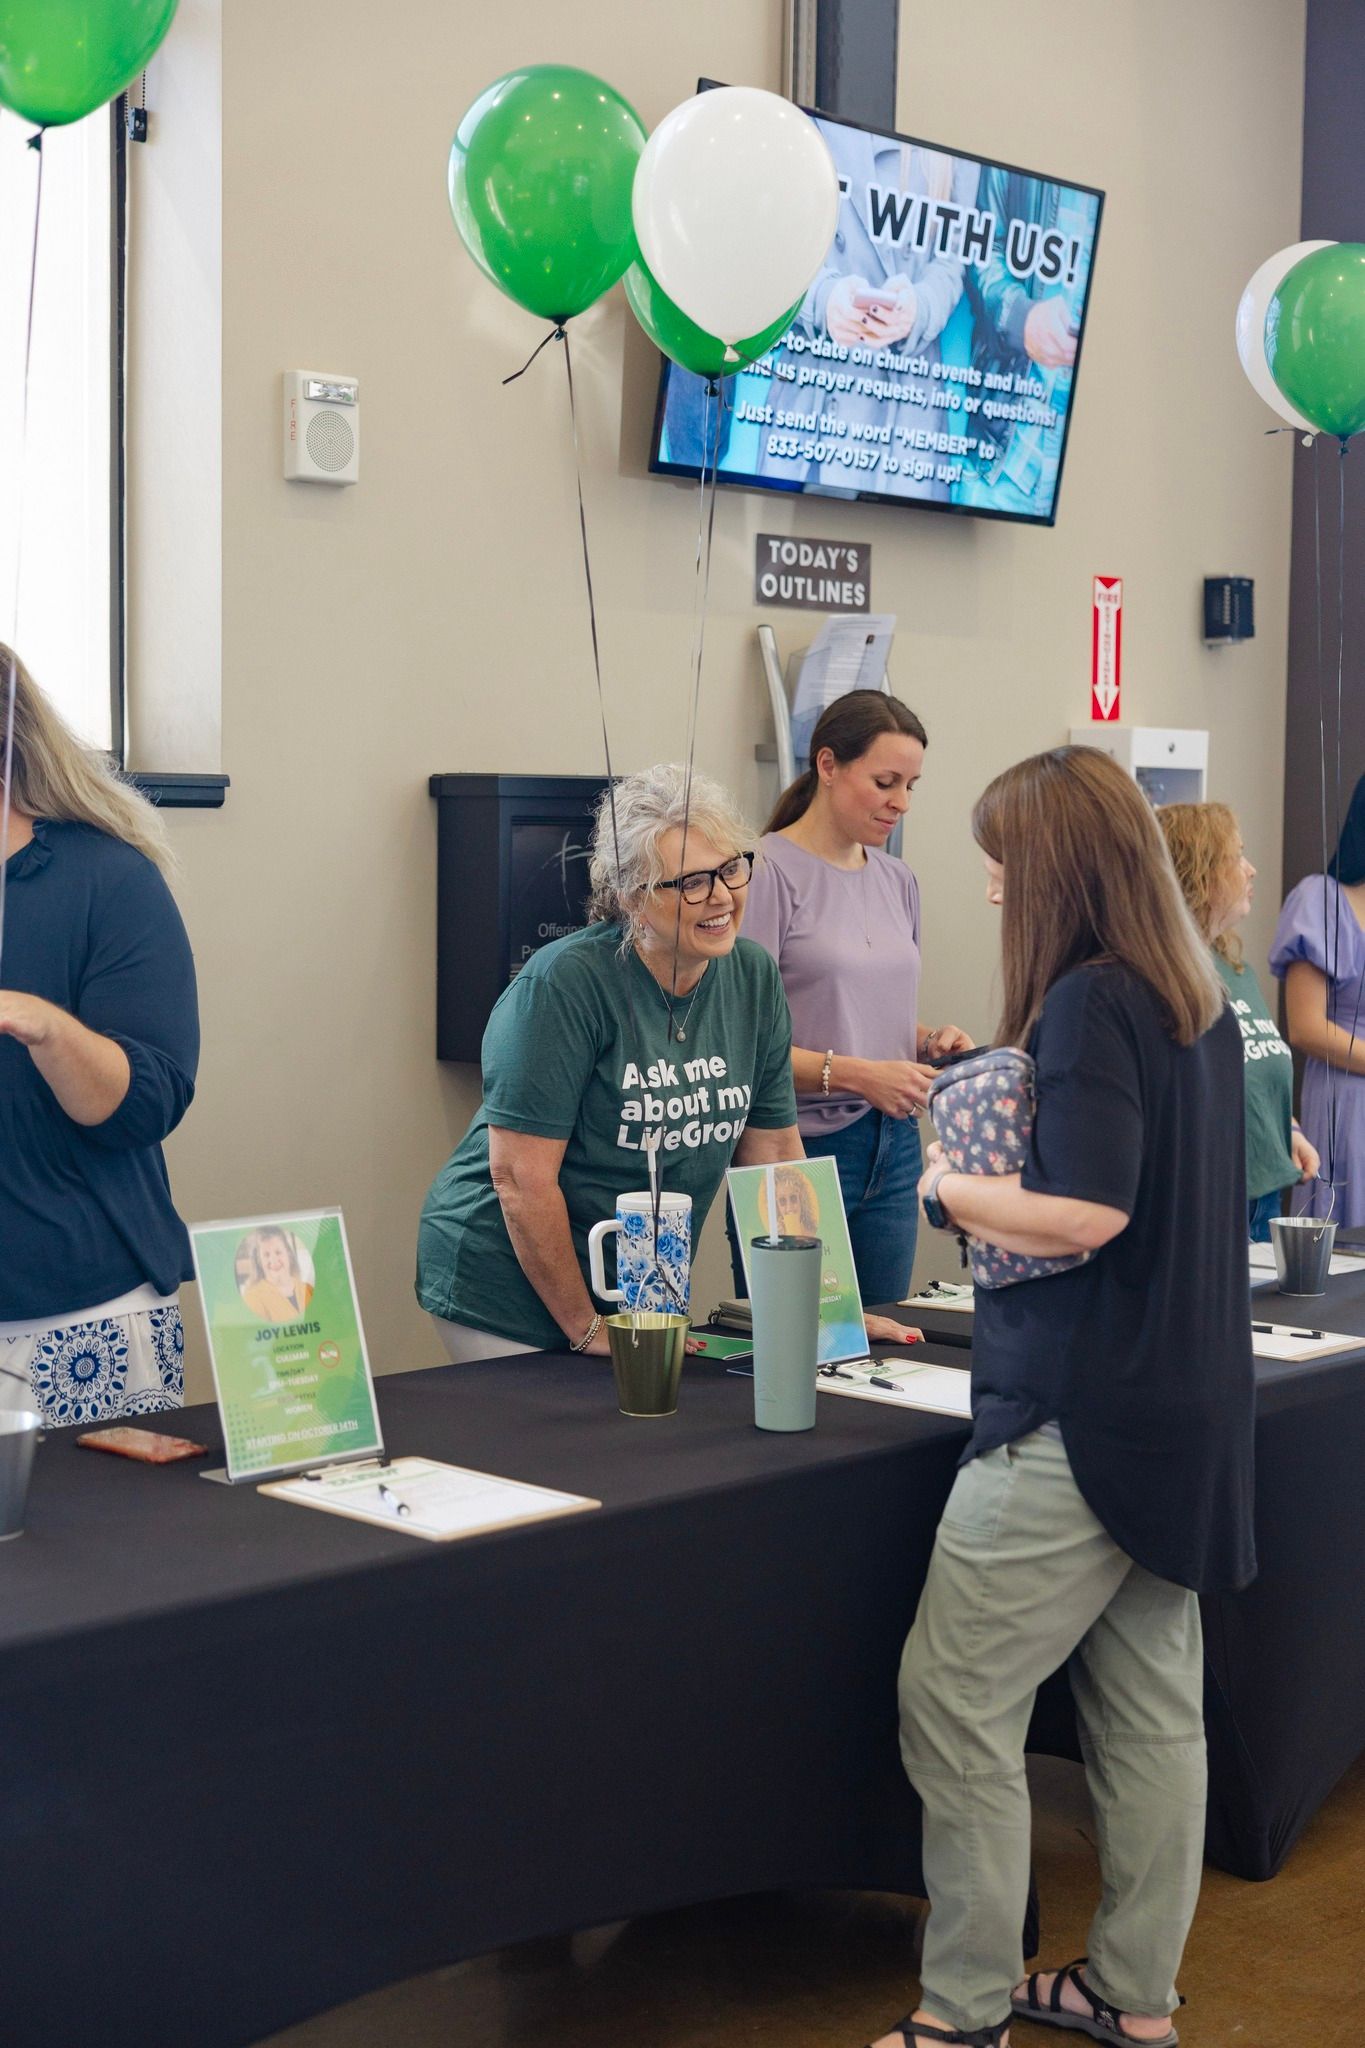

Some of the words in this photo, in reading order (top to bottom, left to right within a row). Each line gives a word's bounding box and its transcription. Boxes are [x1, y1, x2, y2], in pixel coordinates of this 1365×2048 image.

[868, 186, 993, 264] WITH
[1009, 224, 1080, 284] US!
[772, 332, 849, 361] -to-date
[852, 346, 873, 366] on
[876, 346, 929, 376] church
[931, 362, 982, 387] events
[984, 371, 1013, 392] and
[1015, 375, 1048, 400] info,
[776, 362, 796, 382] us
[798, 366, 855, 391] prayer
[856, 376, 928, 408] requests,
[931, 386, 961, 411] info
[963, 396, 981, 414] or
[982, 402, 1058, 428] questions!
[736, 400, 773, 423] Just
[775, 409, 818, 432] send
[819, 412, 847, 437] the
[850, 423, 892, 444] word
[979, 440, 997, 460] to
[766, 434, 880, 470] 833-507-0157
[882, 453, 899, 473] to
[901, 456, 934, 480] sign
[936, 463, 963, 484] up!
[768, 539, 859, 573] TODAY'S
[760, 572, 866, 607] OUTLINES
[538, 922, 586, 938] Offerin
[622, 1058, 680, 1090] Ask
[682, 1055, 728, 1083] me
[620, 1086, 711, 1122] about
[717, 1084, 753, 1111] my
[255, 1327, 280, 1342] JOY
[282, 1321, 321, 1338] LEWIS
